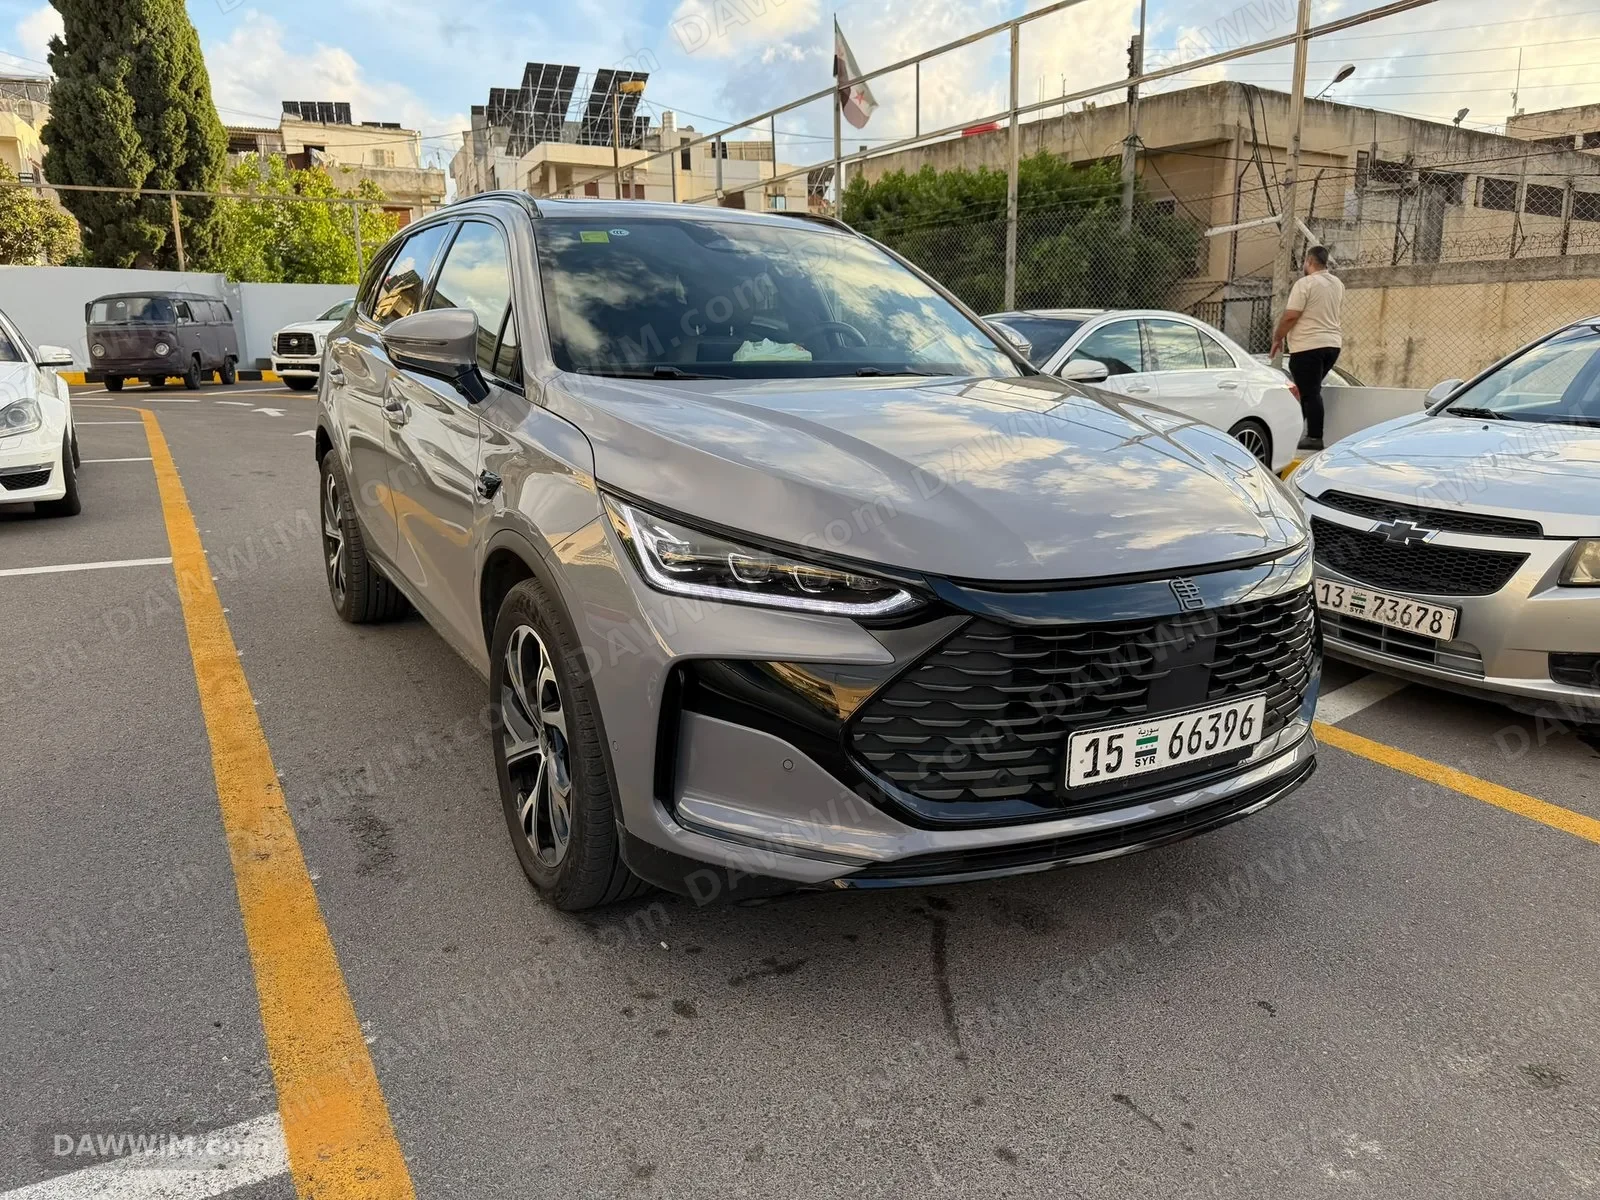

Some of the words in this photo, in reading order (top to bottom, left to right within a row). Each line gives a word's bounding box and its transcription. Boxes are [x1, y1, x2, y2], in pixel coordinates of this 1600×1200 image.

[1320, 583, 1344, 608] 13
[1372, 596, 1443, 633] 73678
[1083, 733, 1124, 779] 15
[1168, 704, 1254, 759] 66396
[1138, 727, 1159, 737] سورية
[1135, 756, 1156, 768] SYR
